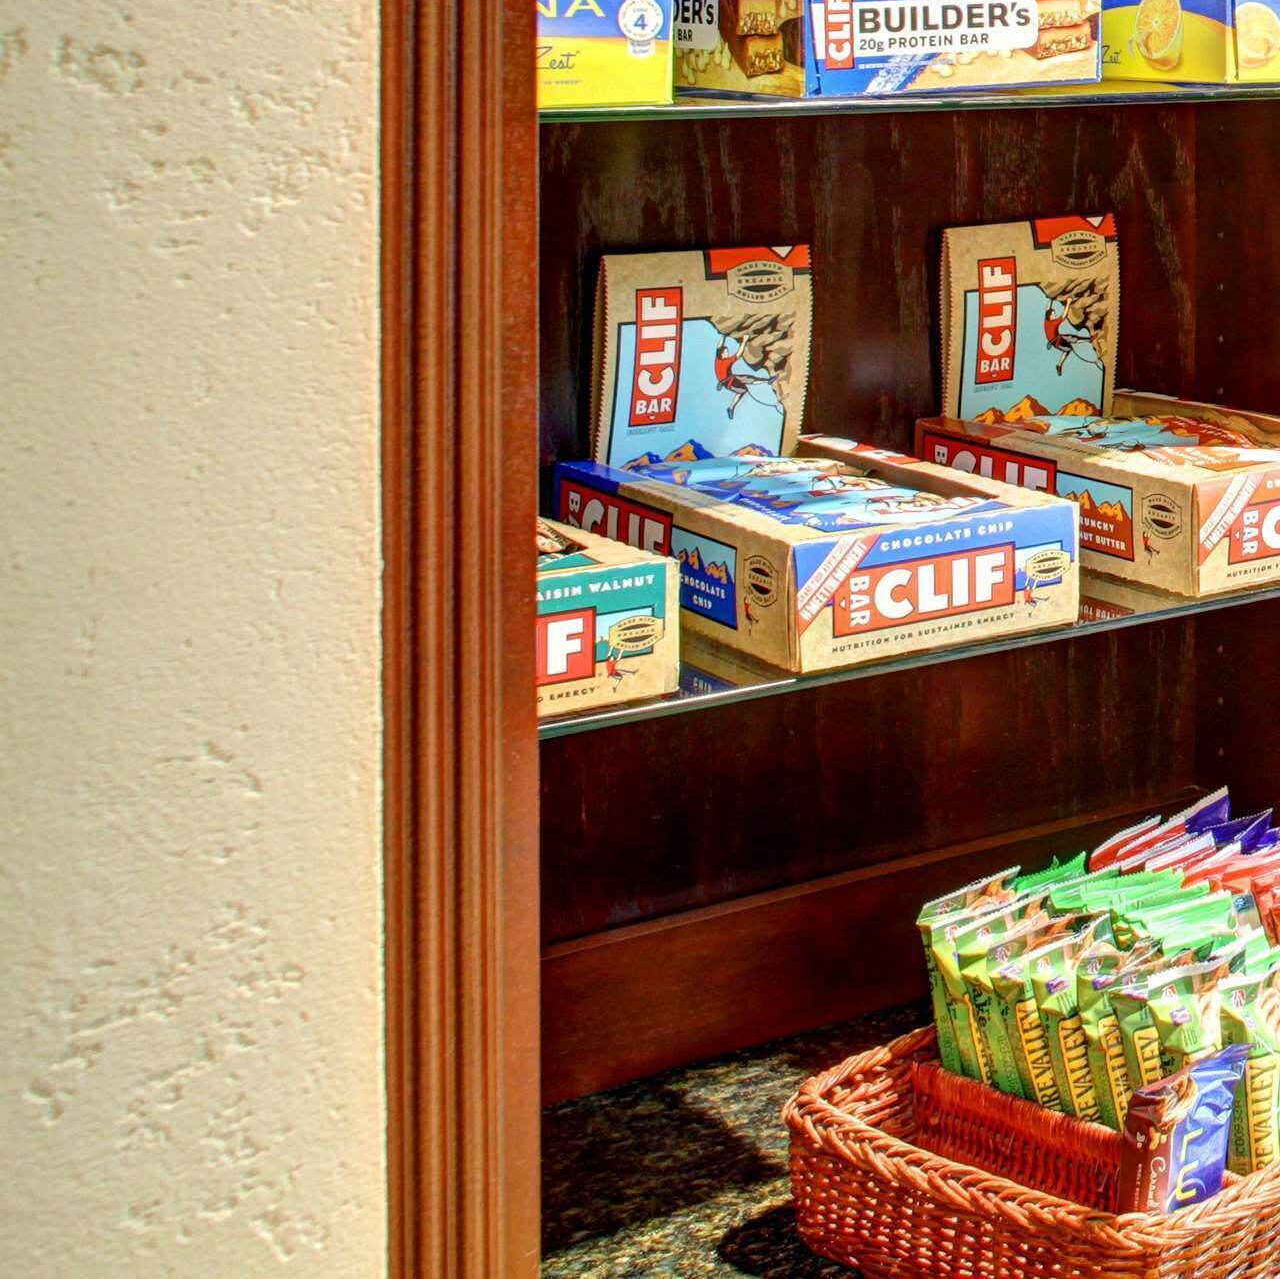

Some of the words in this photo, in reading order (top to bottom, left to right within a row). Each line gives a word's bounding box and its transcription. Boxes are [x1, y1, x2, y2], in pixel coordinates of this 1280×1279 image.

[632, 13, 648, 31] 4
[677, 27, 693, 43] BAR
[859, 37, 885, 53] 20g
[887, 34, 954, 50] PROTEIN
[959, 33, 989, 45] BAR
[761, 262, 784, 272] WITH
[737, 276, 785, 284] ORGANIC
[981, 265, 1013, 357] CLIF
[637, 295, 679, 397] CLIF
[980, 357, 1011, 374] BAR
[634, 397, 673, 416] BAR
[880, 528, 972, 553] CHOCOLATE
[977, 521, 1015, 535] CHIP
[1241, 509, 1261, 556] BAR
[1095, 534, 1126, 552] BUTTER
[1226, 564, 1273, 578] NUTRITION
[588, 574, 656, 593] WALNUT
[873, 551, 1006, 620] CLIF
[692, 595, 713, 610] CHIP
[848, 575, 871, 627] BAR
[831, 636, 891, 654] NUTRITION
[893, 632, 914, 643] FOR
[917, 619, 974, 637] SUSTAINED
[976, 611, 1016, 626] ENERGY
[549, 686, 597, 702] ENERGY
[1019, 1009, 1053, 1079] VALLEY
[1060, 1026, 1095, 1099] VALLEY
[1250, 1059, 1275, 1146] VALLEY
